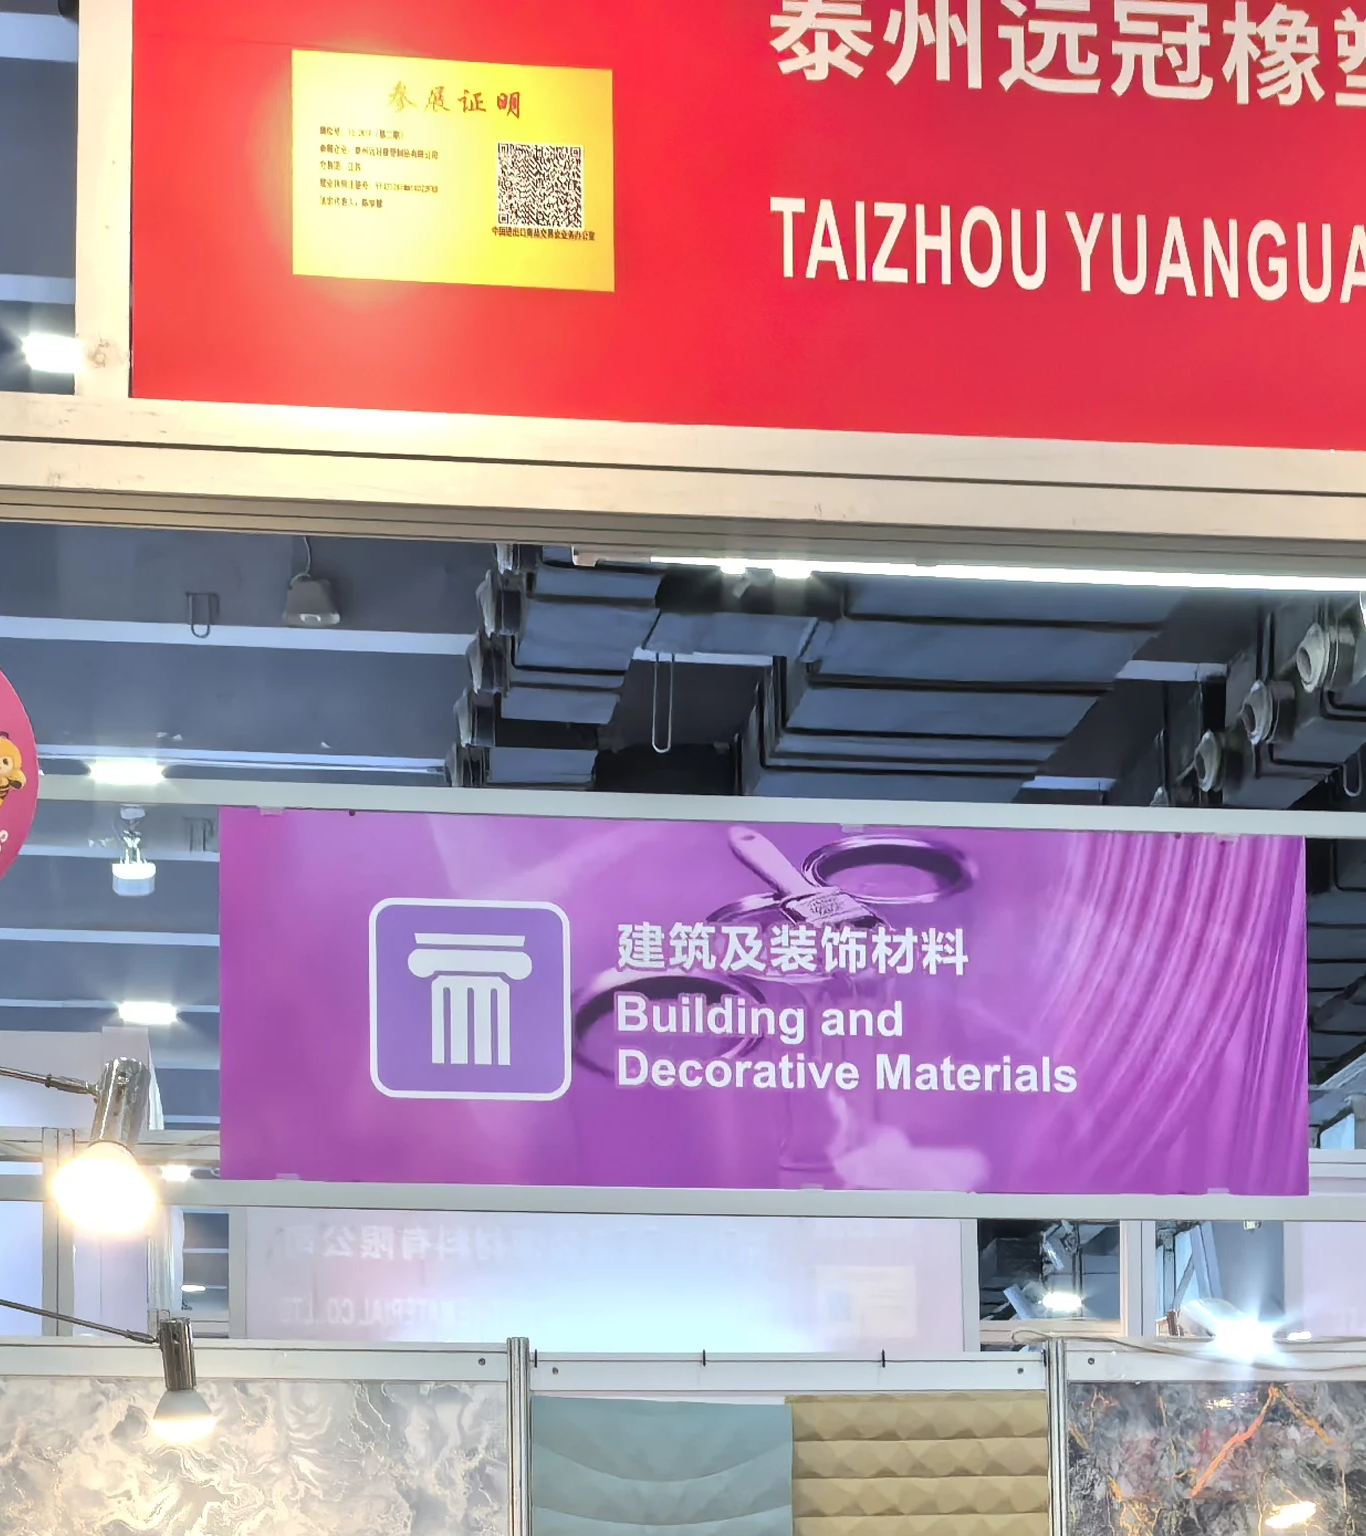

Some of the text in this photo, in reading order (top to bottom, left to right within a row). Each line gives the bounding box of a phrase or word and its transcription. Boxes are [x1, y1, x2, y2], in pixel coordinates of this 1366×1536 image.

[389, 81, 521, 119] 参展证明
[771, 197, 1046, 290] TAIZHOU
[618, 922, 969, 975] 建筑及装饰材料
[616, 995, 903, 1044] Building and
[618, 1049, 1077, 1093] Decorative Materials
